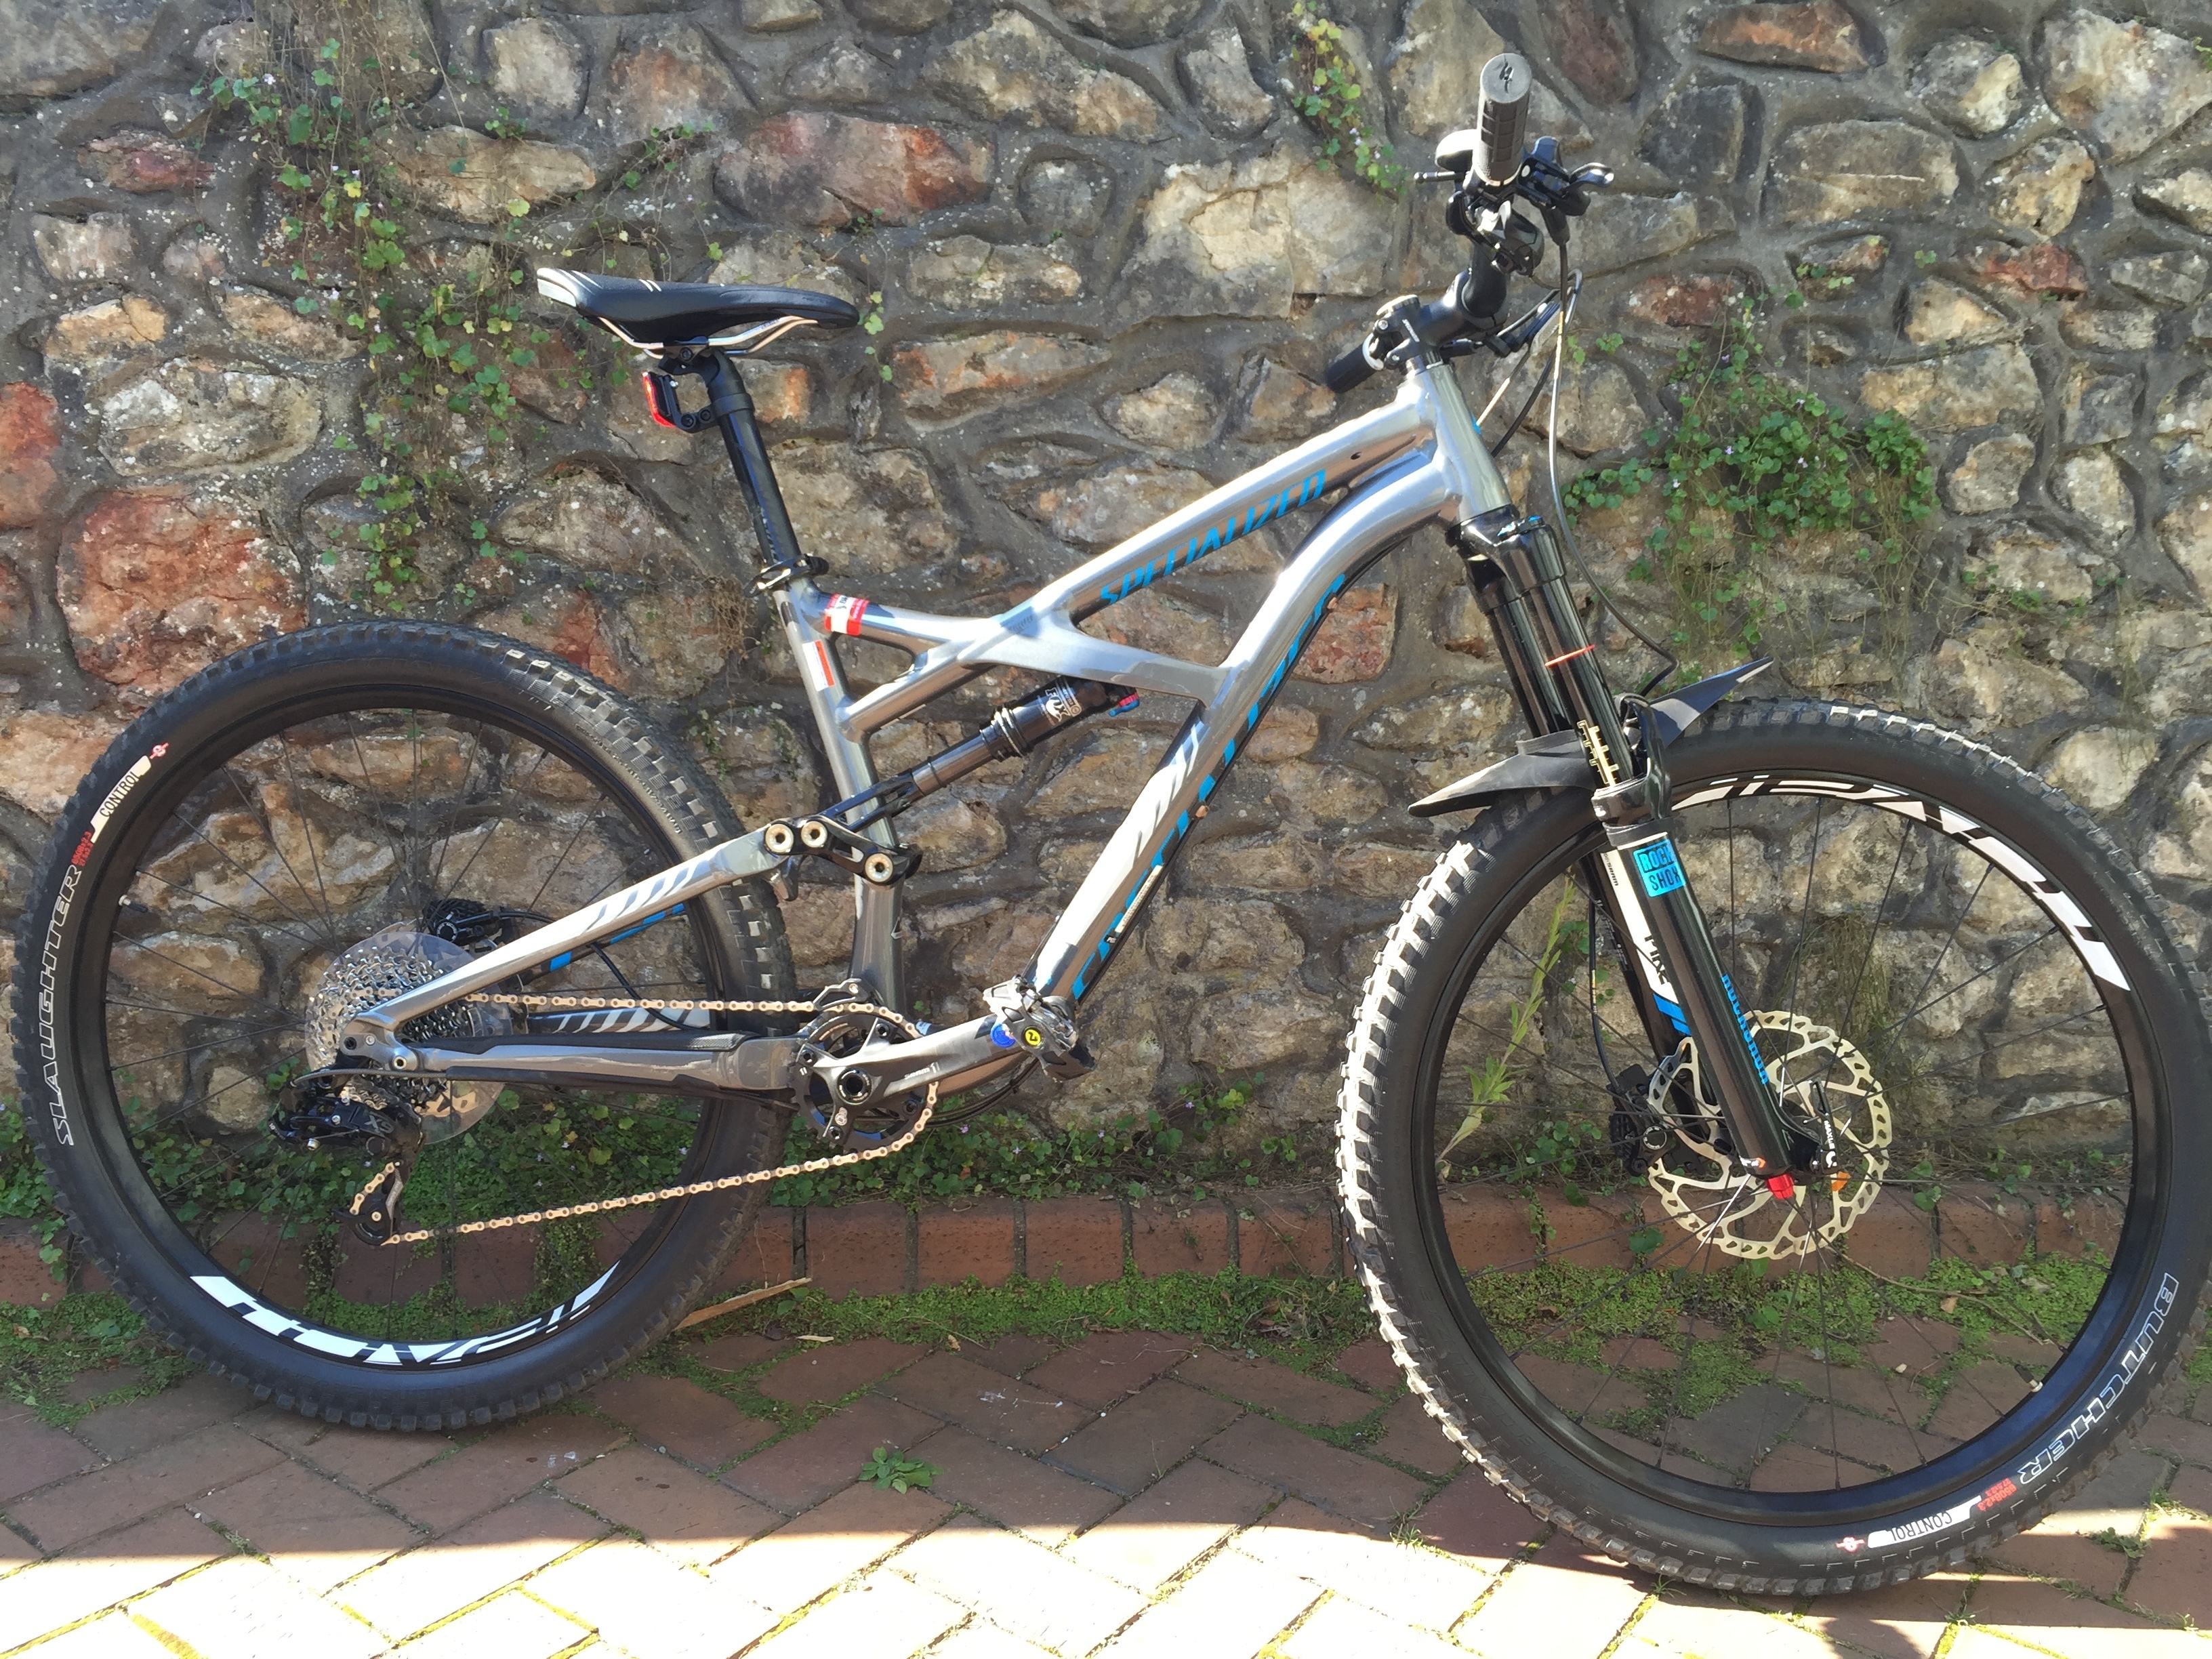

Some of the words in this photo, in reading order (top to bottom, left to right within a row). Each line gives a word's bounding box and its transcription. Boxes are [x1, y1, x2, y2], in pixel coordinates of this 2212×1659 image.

[1044, 687, 1071, 722] FOX
[99, 771, 140, 818] CONTROL
[1638, 844, 1673, 872] ROCK
[1648, 865, 1681, 891] SHOX
[38, 863, 81, 1146] SLAUGHTER
[364, 1115, 395, 1135] X9
[2017, 1272, 2179, 1485] BUTCHER
[1892, 1511, 1953, 1542] CONTROL
